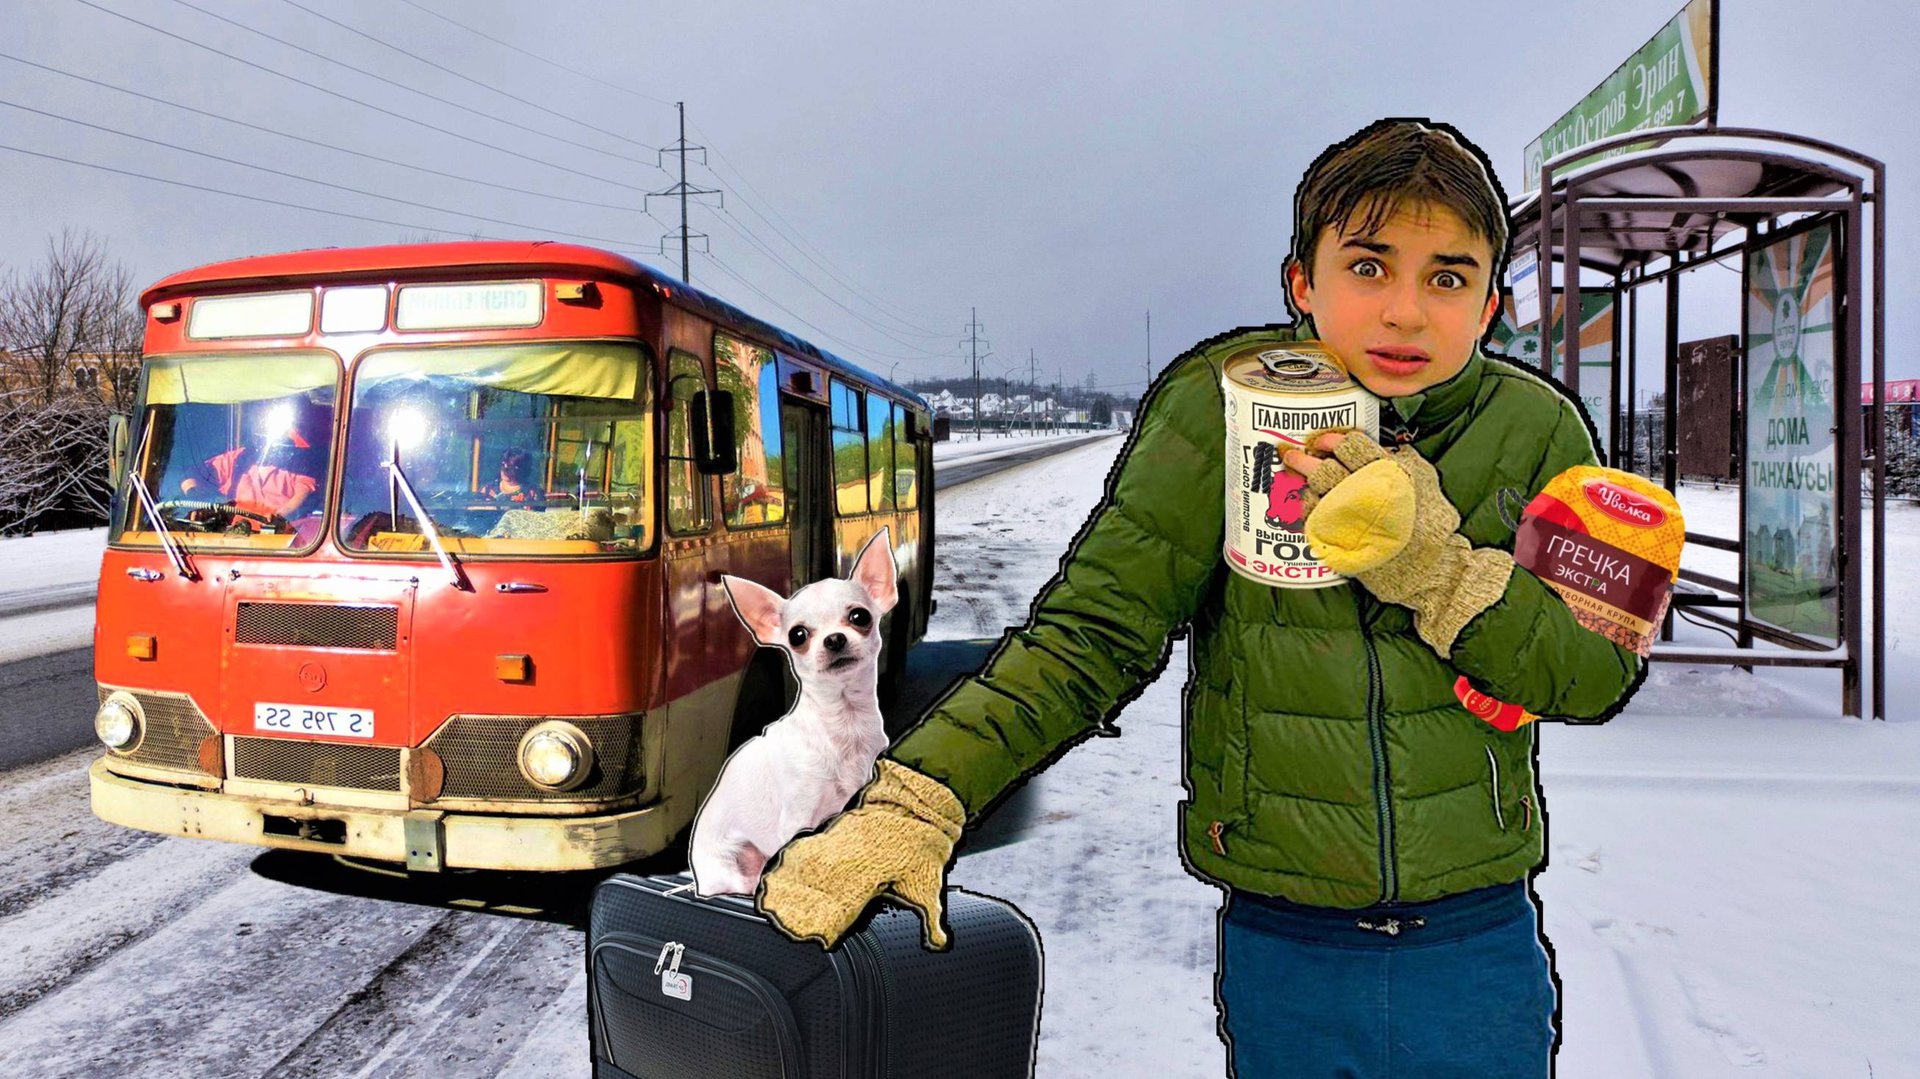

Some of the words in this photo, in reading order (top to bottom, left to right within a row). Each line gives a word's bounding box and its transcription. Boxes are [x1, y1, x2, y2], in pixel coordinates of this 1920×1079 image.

[1575, 90, 1626, 145] Остров
[1633, 43, 1681, 115] Эрин
[1677, 88, 1686, 113] 7
[1258, 407, 1352, 431] ГЛАВПРОДУКТ
[1767, 416, 1810, 450] ДОМА
[1242, 464, 1250, 488] СОРТ
[1752, 461, 1832, 491] ТАНХАУСЫ
[1242, 490, 1250, 532] ВЫСШИЙ
[1598, 486, 1652, 522] Увелка
[1256, 528, 1309, 543] ВЫСШИ
[1256, 538, 1328, 561] ГОС
[1546, 535, 1630, 586] ГРЕЧКА
[1253, 560, 1337, 578] ЭКСТР
[1554, 564, 1607, 595] ЭКСТРА
[1606, 609, 1636, 626] КРУПА
